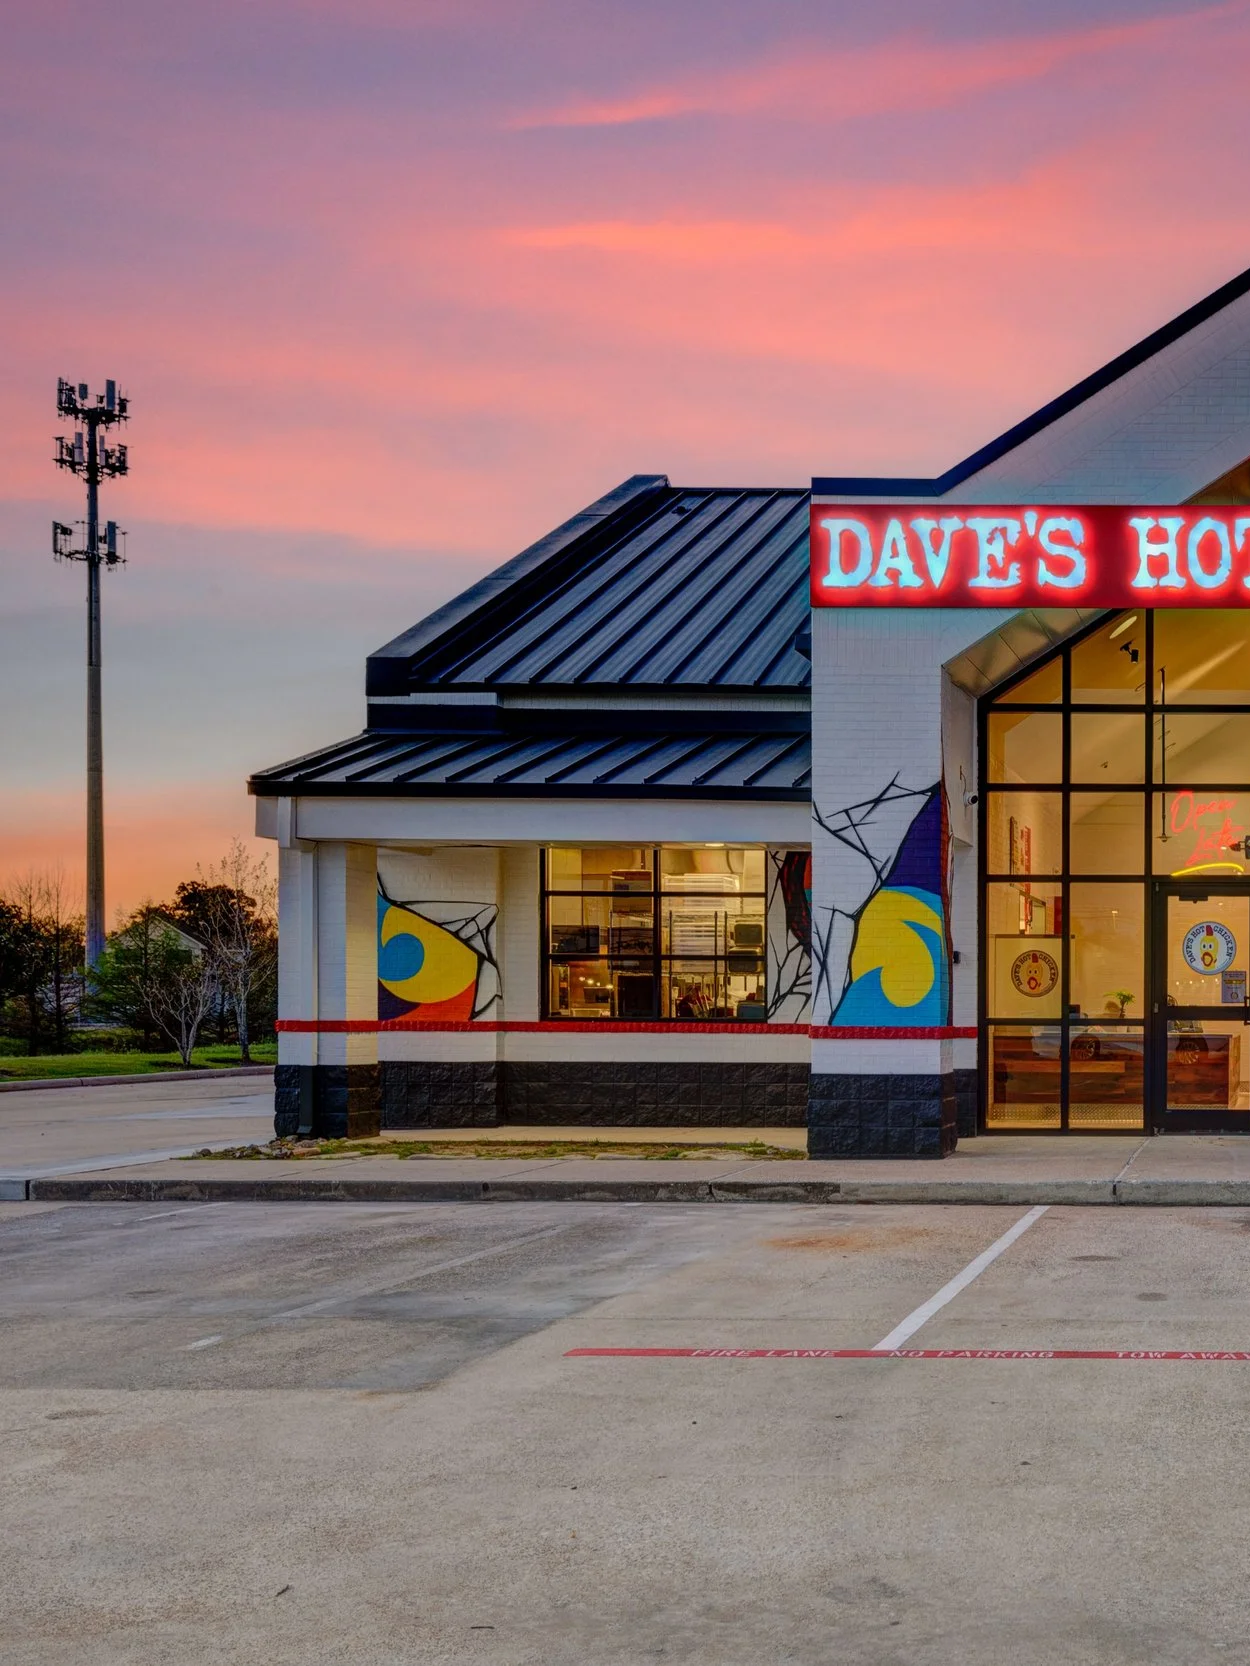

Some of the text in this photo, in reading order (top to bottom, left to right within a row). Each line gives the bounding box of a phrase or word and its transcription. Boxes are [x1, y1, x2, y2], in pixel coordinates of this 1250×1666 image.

[819, 510, 1088, 590] DAVE'S
[1191, 925, 1206, 939] HOT
[1212, 925, 1234, 958] CHICKEN
[690, 1349, 756, 1358] FIRE
[765, 1350, 841, 1358] LANE
[889, 1350, 926, 1358] NO
[936, 1350, 1054, 1359] PARKING
[1116, 1351, 1168, 1360] TOW
